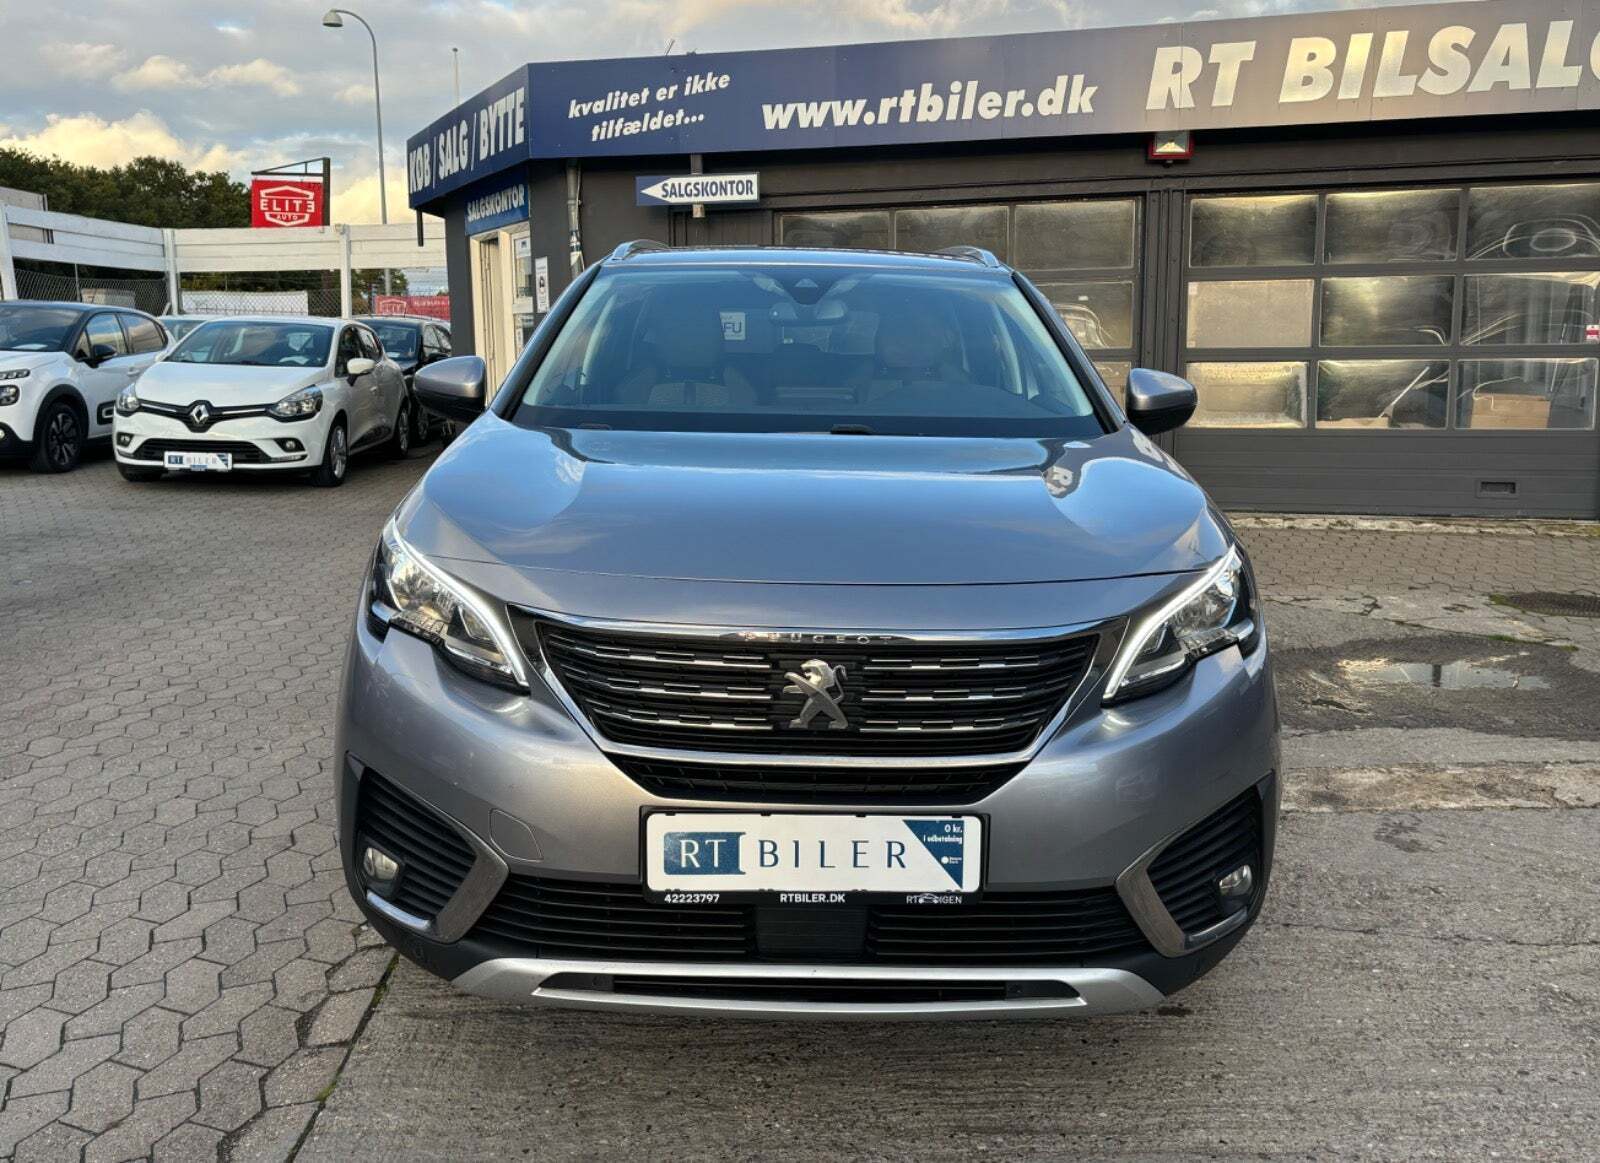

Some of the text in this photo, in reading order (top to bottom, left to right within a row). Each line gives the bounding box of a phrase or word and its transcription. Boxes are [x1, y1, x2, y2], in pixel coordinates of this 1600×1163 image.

[1146, 19, 1600, 110] RT BILSAL
[568, 71, 731, 119] kvalitet er ikke
[762, 74, 1098, 130] www.rtbiler.dk
[439, 119, 468, 180] SALG
[480, 87, 525, 161] BYTTE
[591, 109, 705, 142] tilfældet...
[467, 184, 525, 222] SALGSKONTOR
[661, 179, 754, 199] SALGSKONTOR
[260, 198, 315, 213] ELITE
[276, 212, 298, 220] AUTO
[944, 823, 952, 833] 0
[680, 839, 907, 869] RT BILER
[664, 893, 720, 904] 42223797
[779, 892, 846, 904] RTBILER.DK
